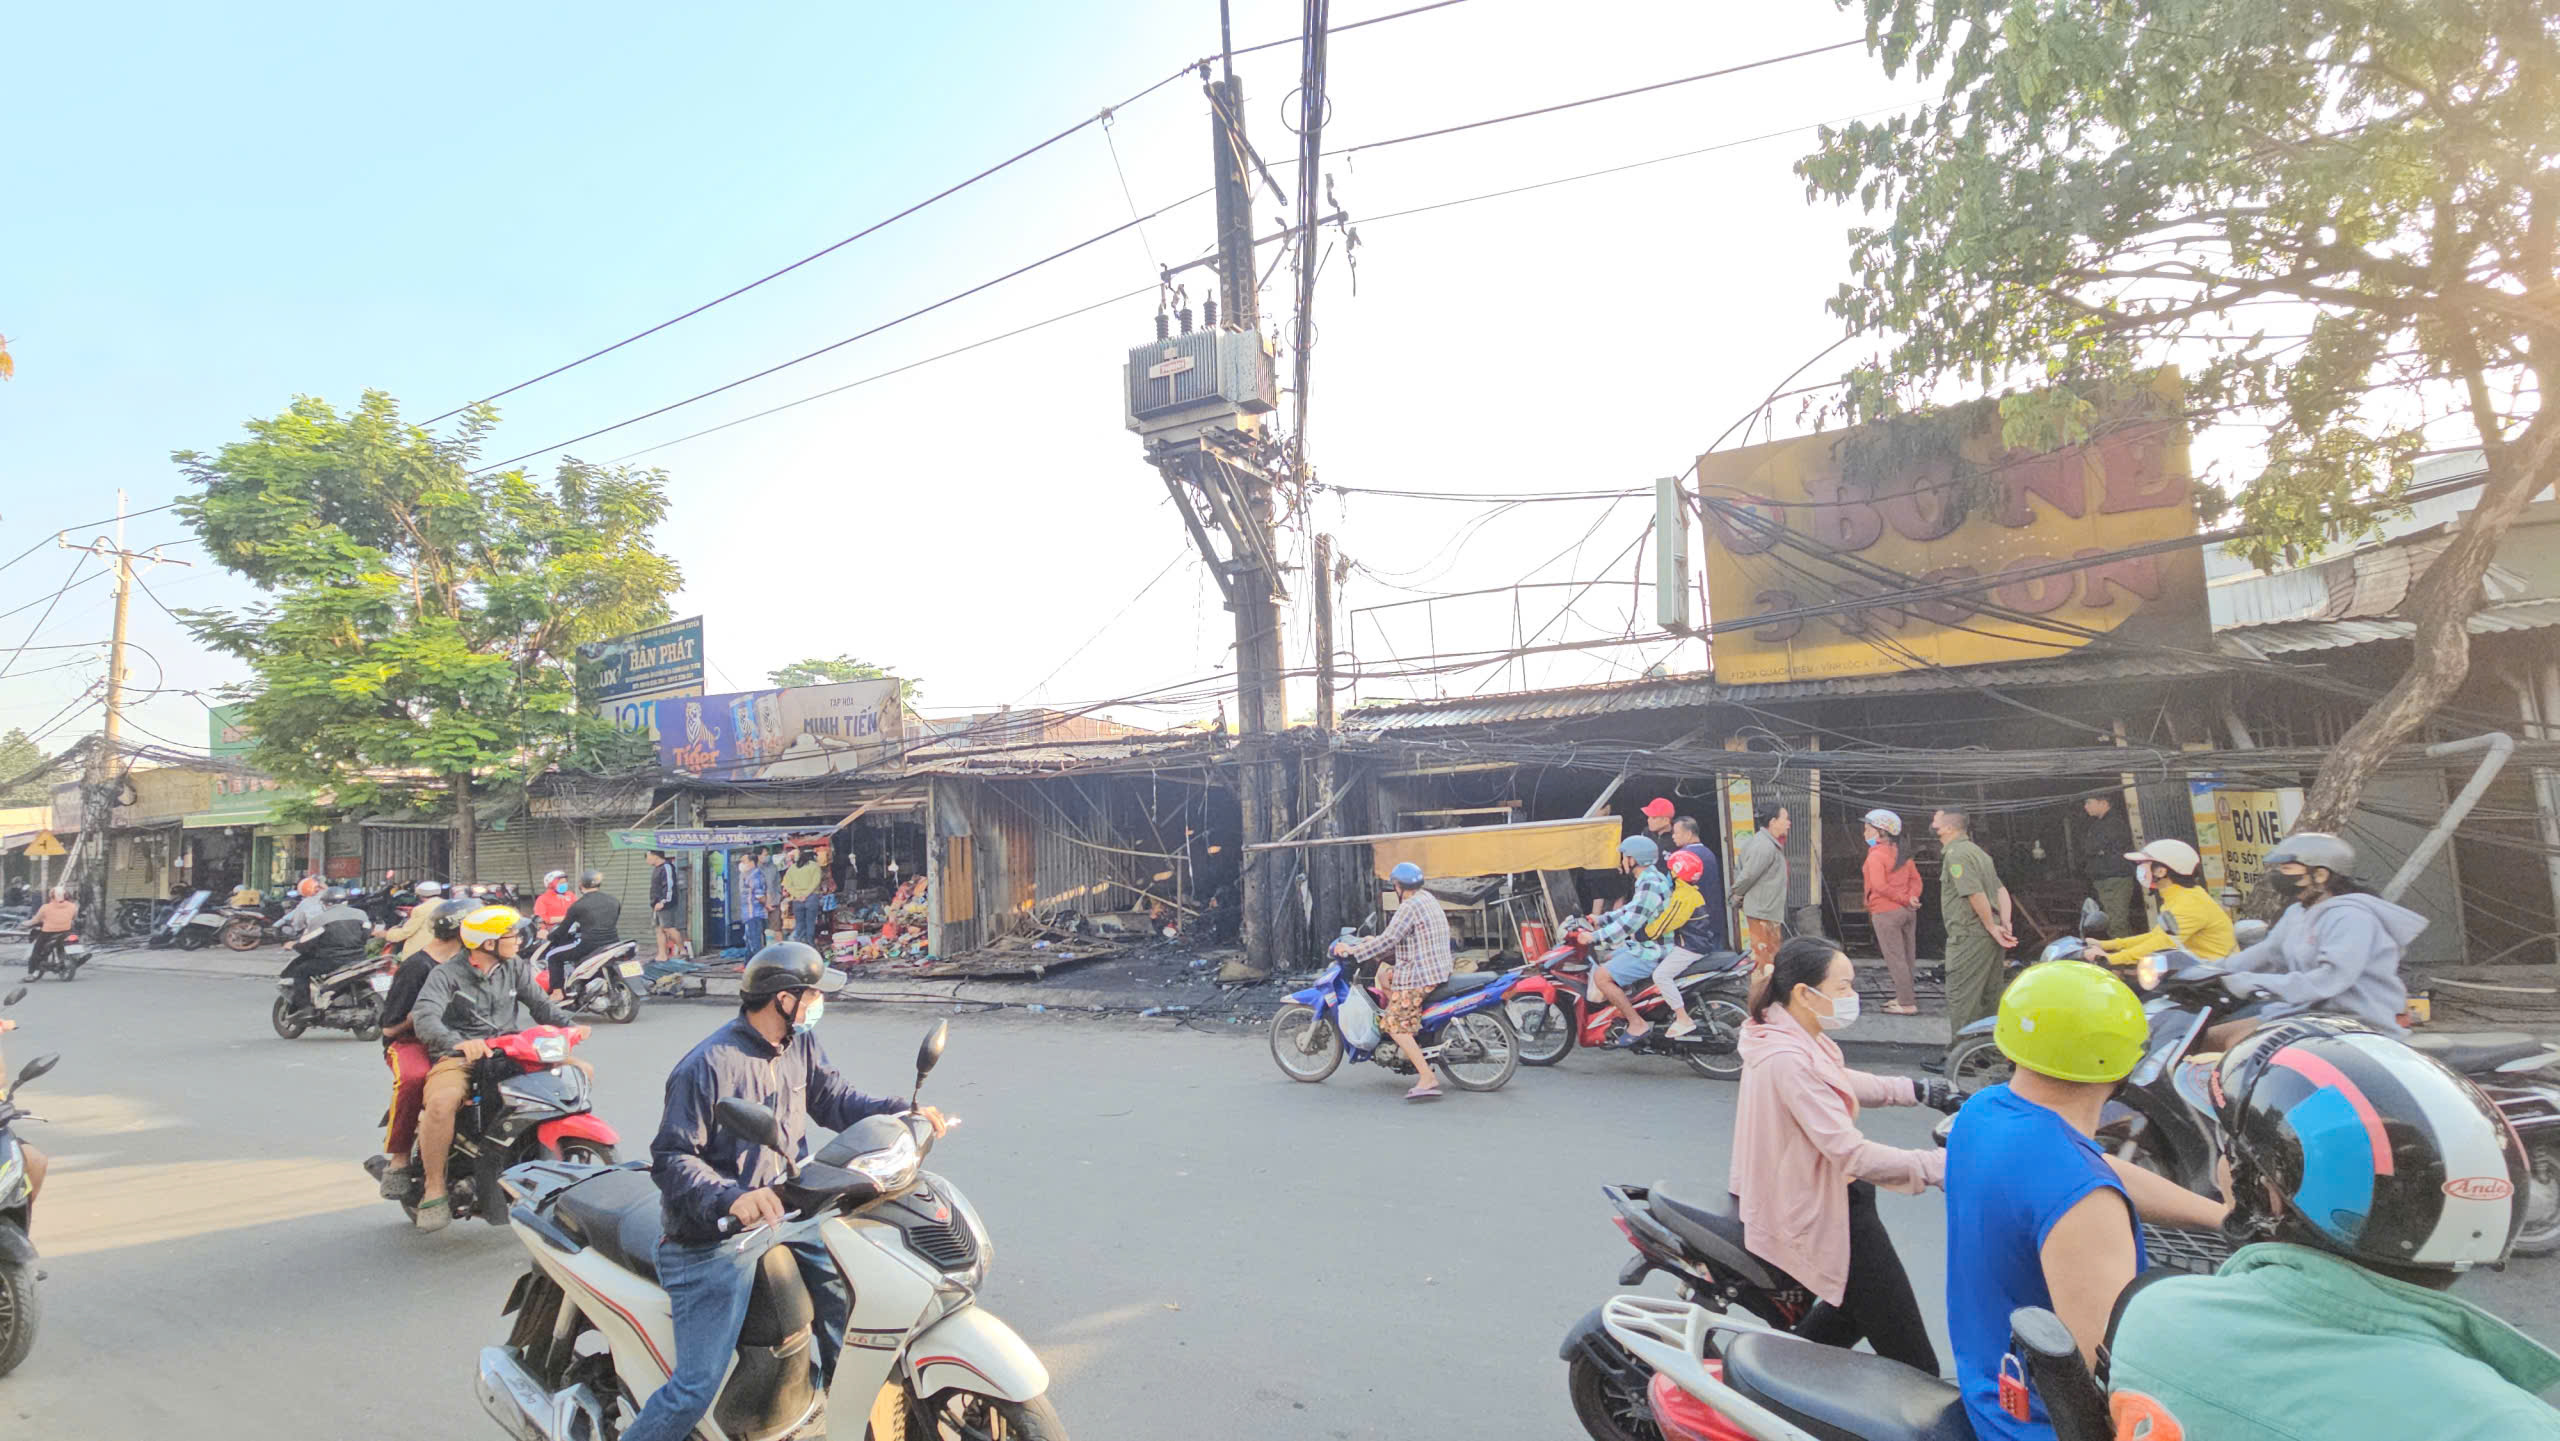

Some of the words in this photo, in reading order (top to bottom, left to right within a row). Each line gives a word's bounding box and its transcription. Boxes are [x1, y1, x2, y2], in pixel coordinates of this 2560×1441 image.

[659, 635, 695, 665] PHÁT
[803, 716, 839, 737] MINH
[844, 706, 878, 737] TIẾN
[673, 743, 720, 773] Tiger
[2231, 800, 2255, 844] BÒ
[2256, 801, 2282, 846] NÉ
